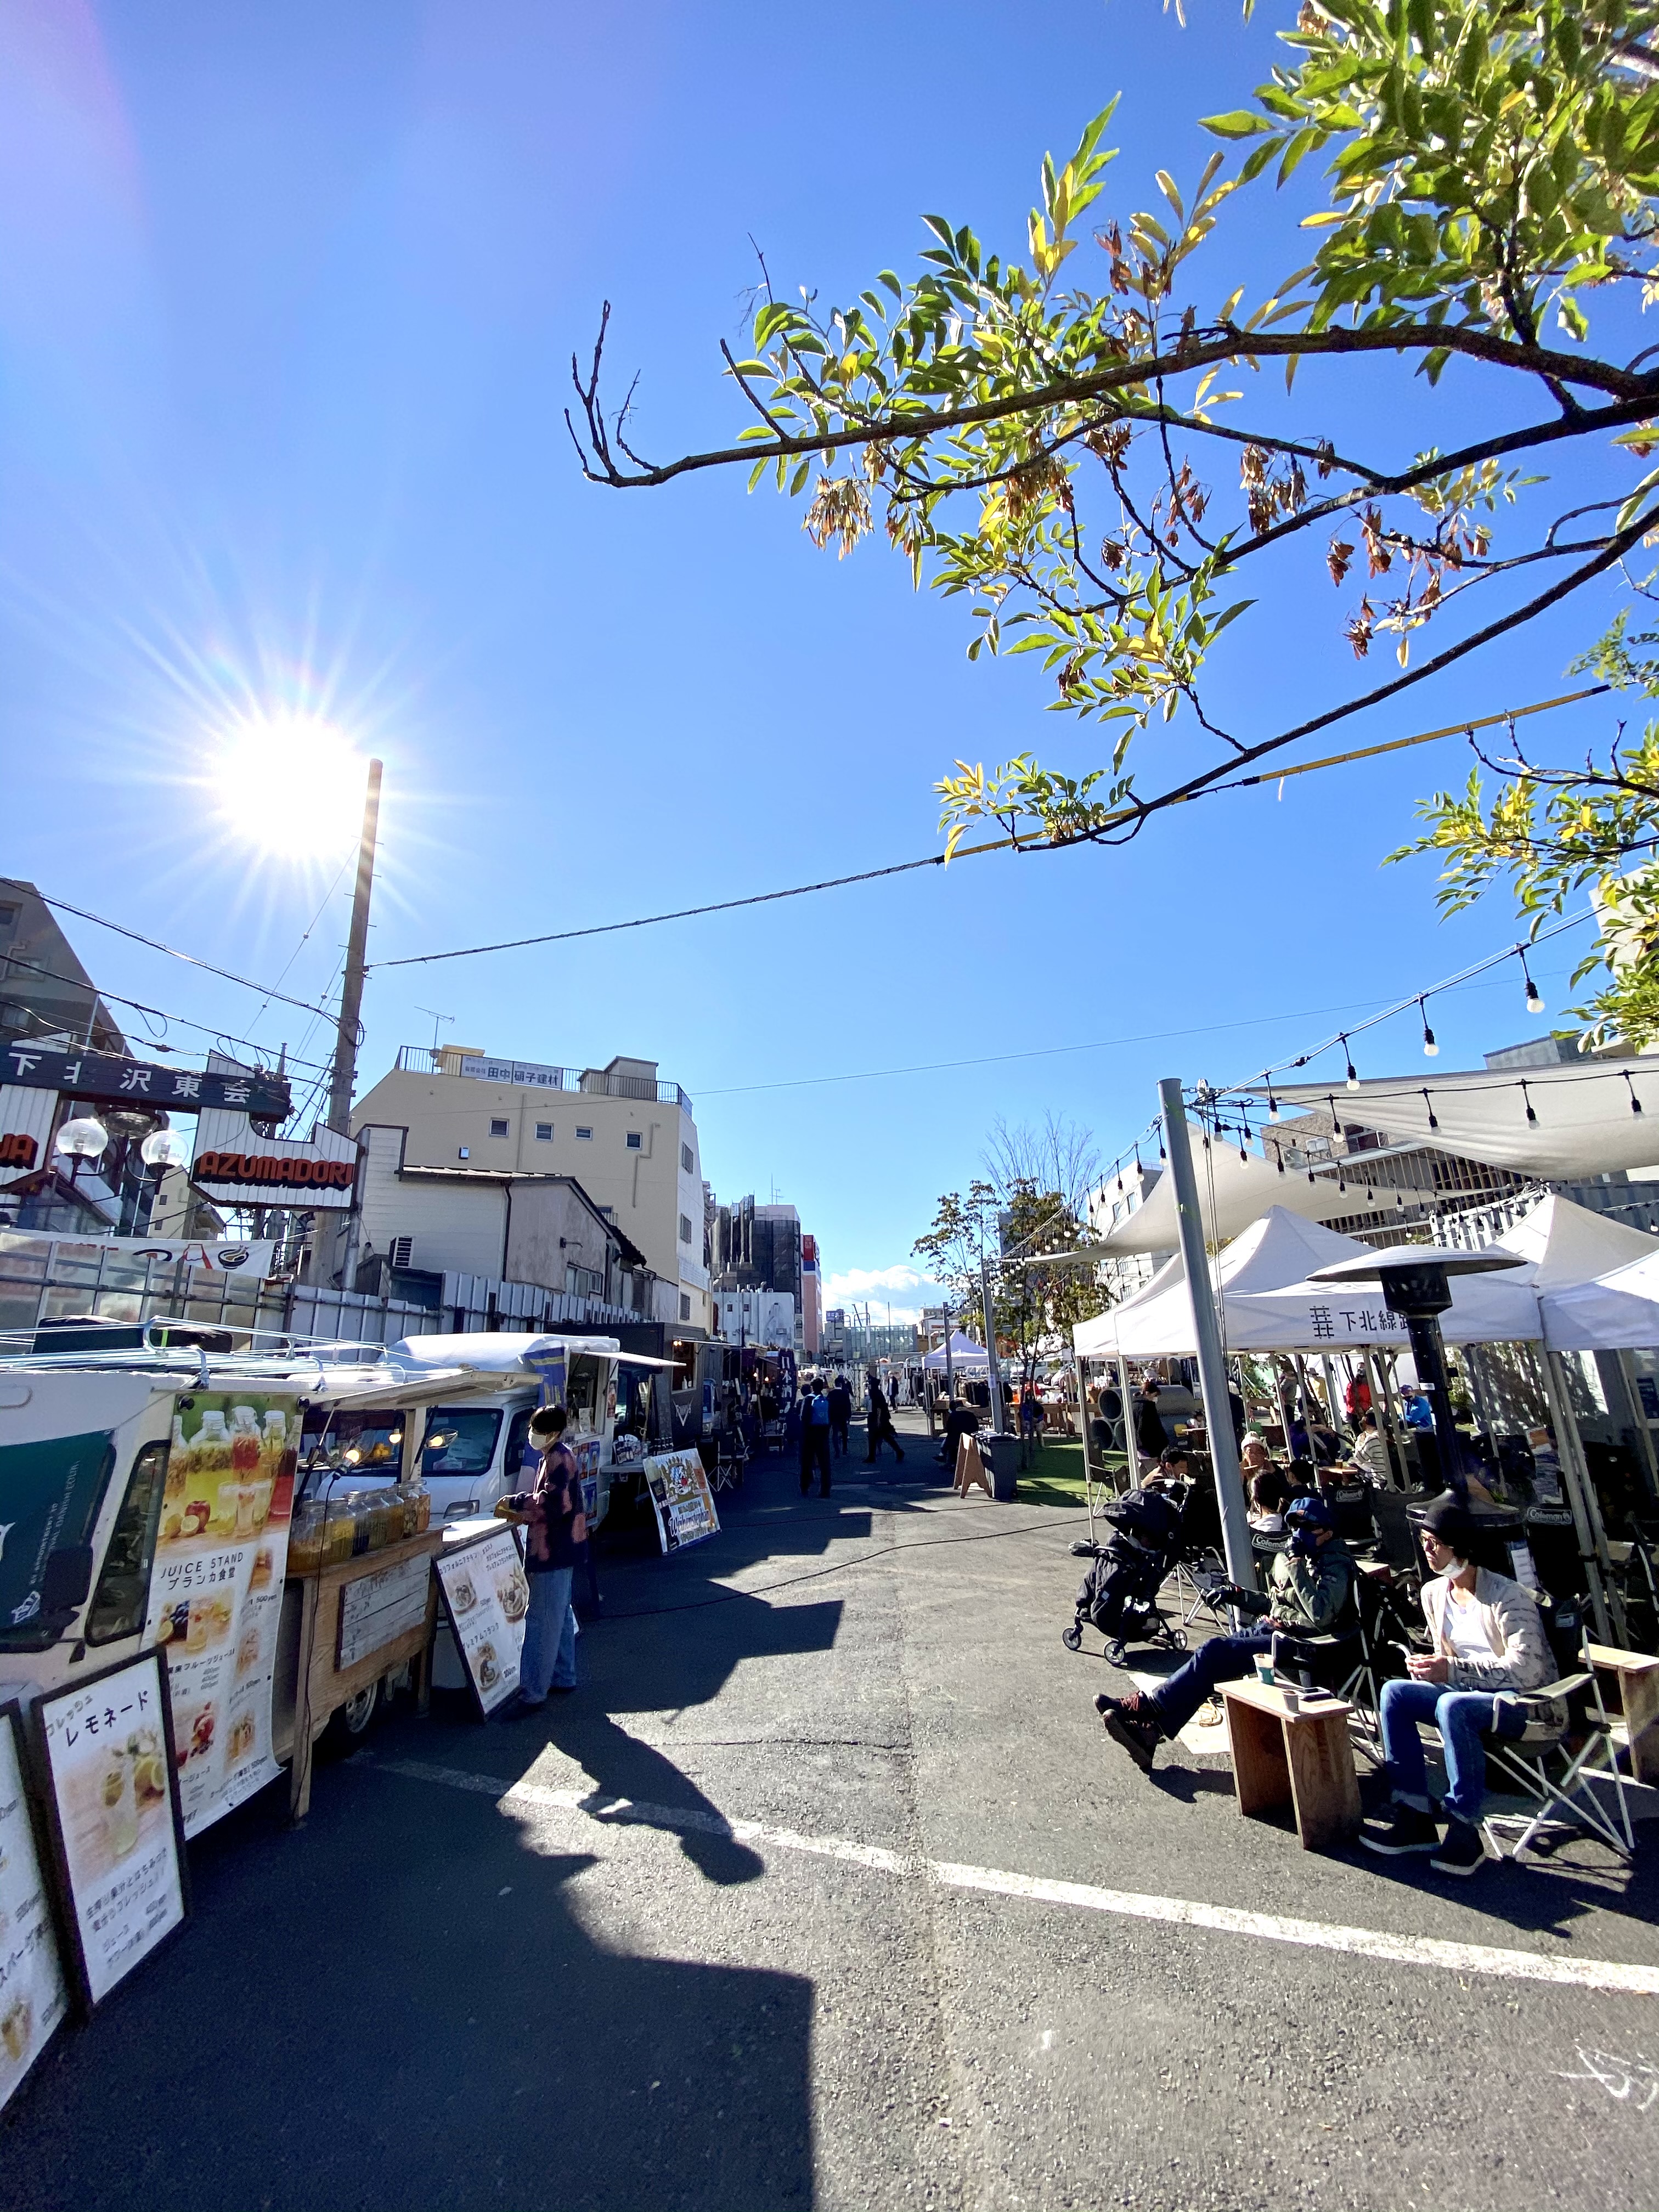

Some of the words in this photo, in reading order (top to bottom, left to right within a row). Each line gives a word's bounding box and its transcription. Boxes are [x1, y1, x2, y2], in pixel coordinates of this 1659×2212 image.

[488, 1066, 558, 1086] 田中硝子建材
[199, 1150, 354, 1184] AZUMADORI
[1530, 1509, 1564, 1522] Coleman
[160, 1561, 202, 1579] JUICE
[211, 1551, 244, 1568] STAND
[64, 1690, 149, 1747] レモネード
